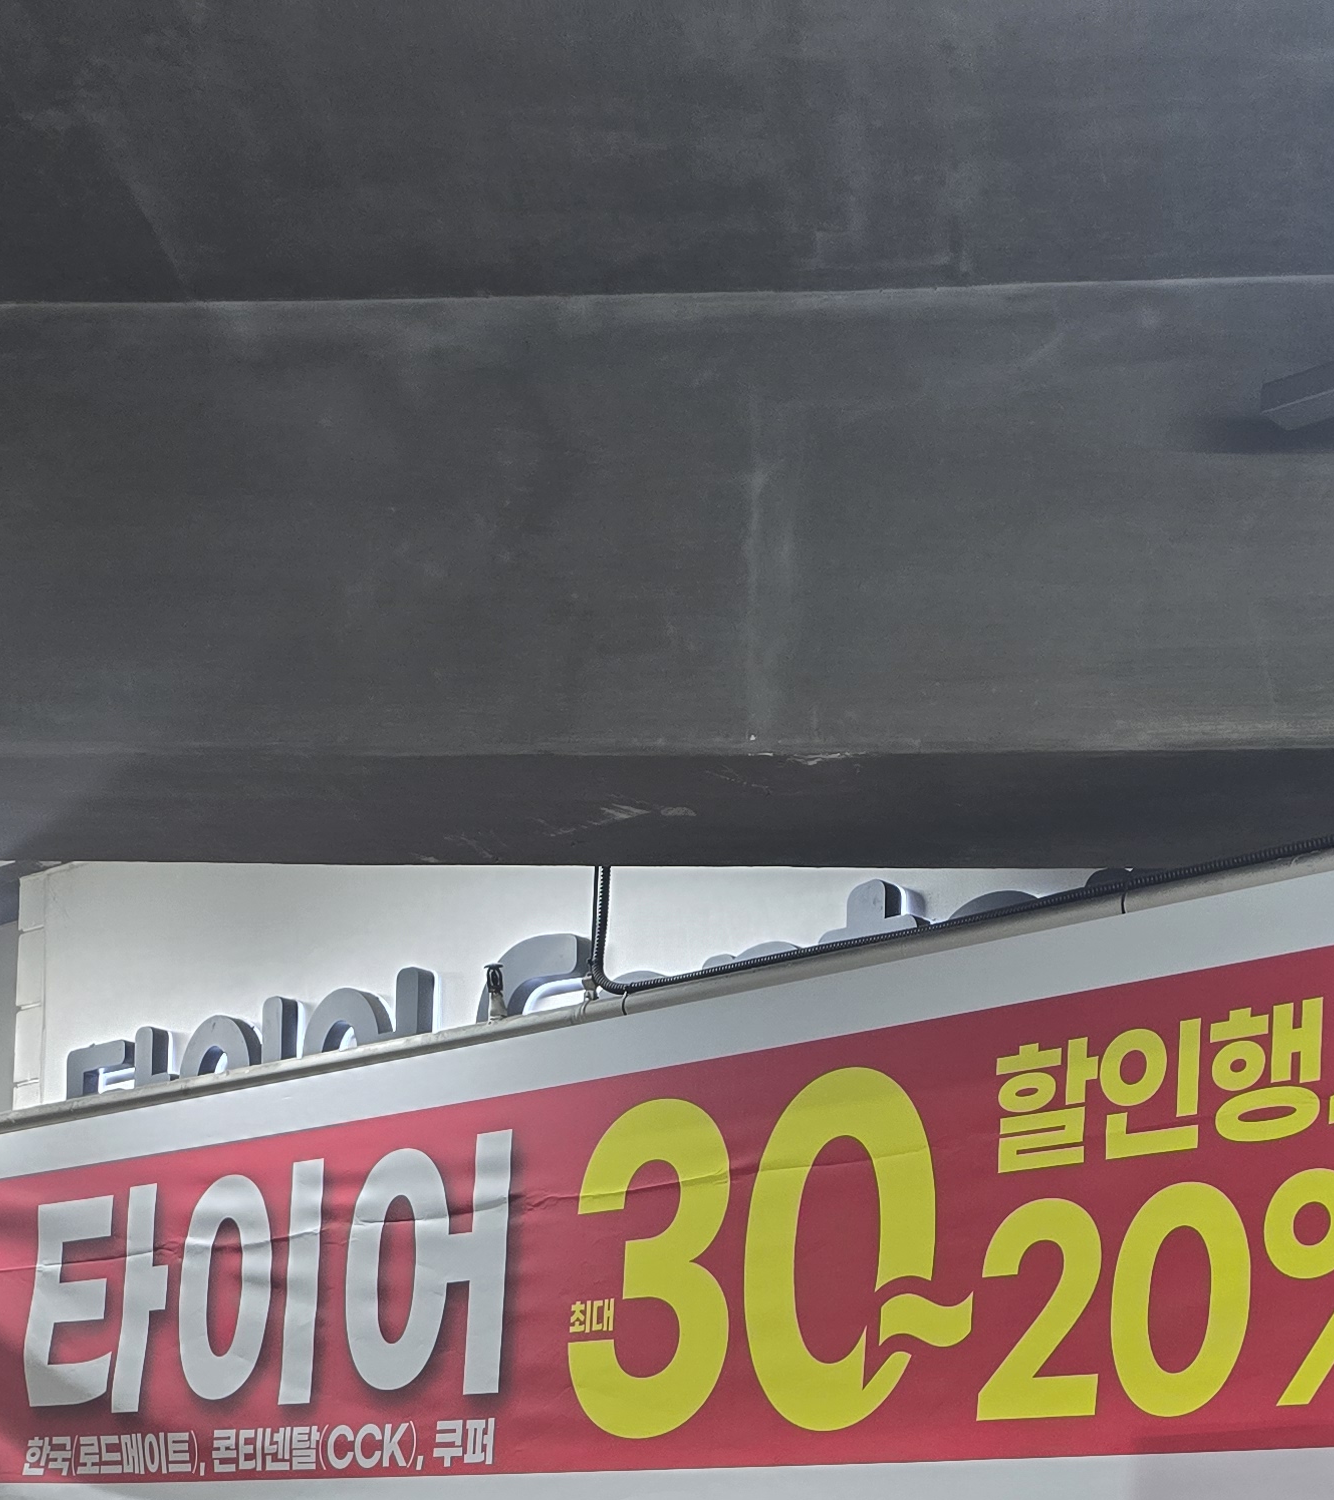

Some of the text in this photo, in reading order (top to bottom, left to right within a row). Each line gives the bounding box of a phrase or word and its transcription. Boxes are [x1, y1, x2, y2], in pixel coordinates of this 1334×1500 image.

[22, 1128, 513, 1413] 타이어
[568, 1298, 615, 1334] 최대
[432, 1417, 495, 1467] 쿠퍼
